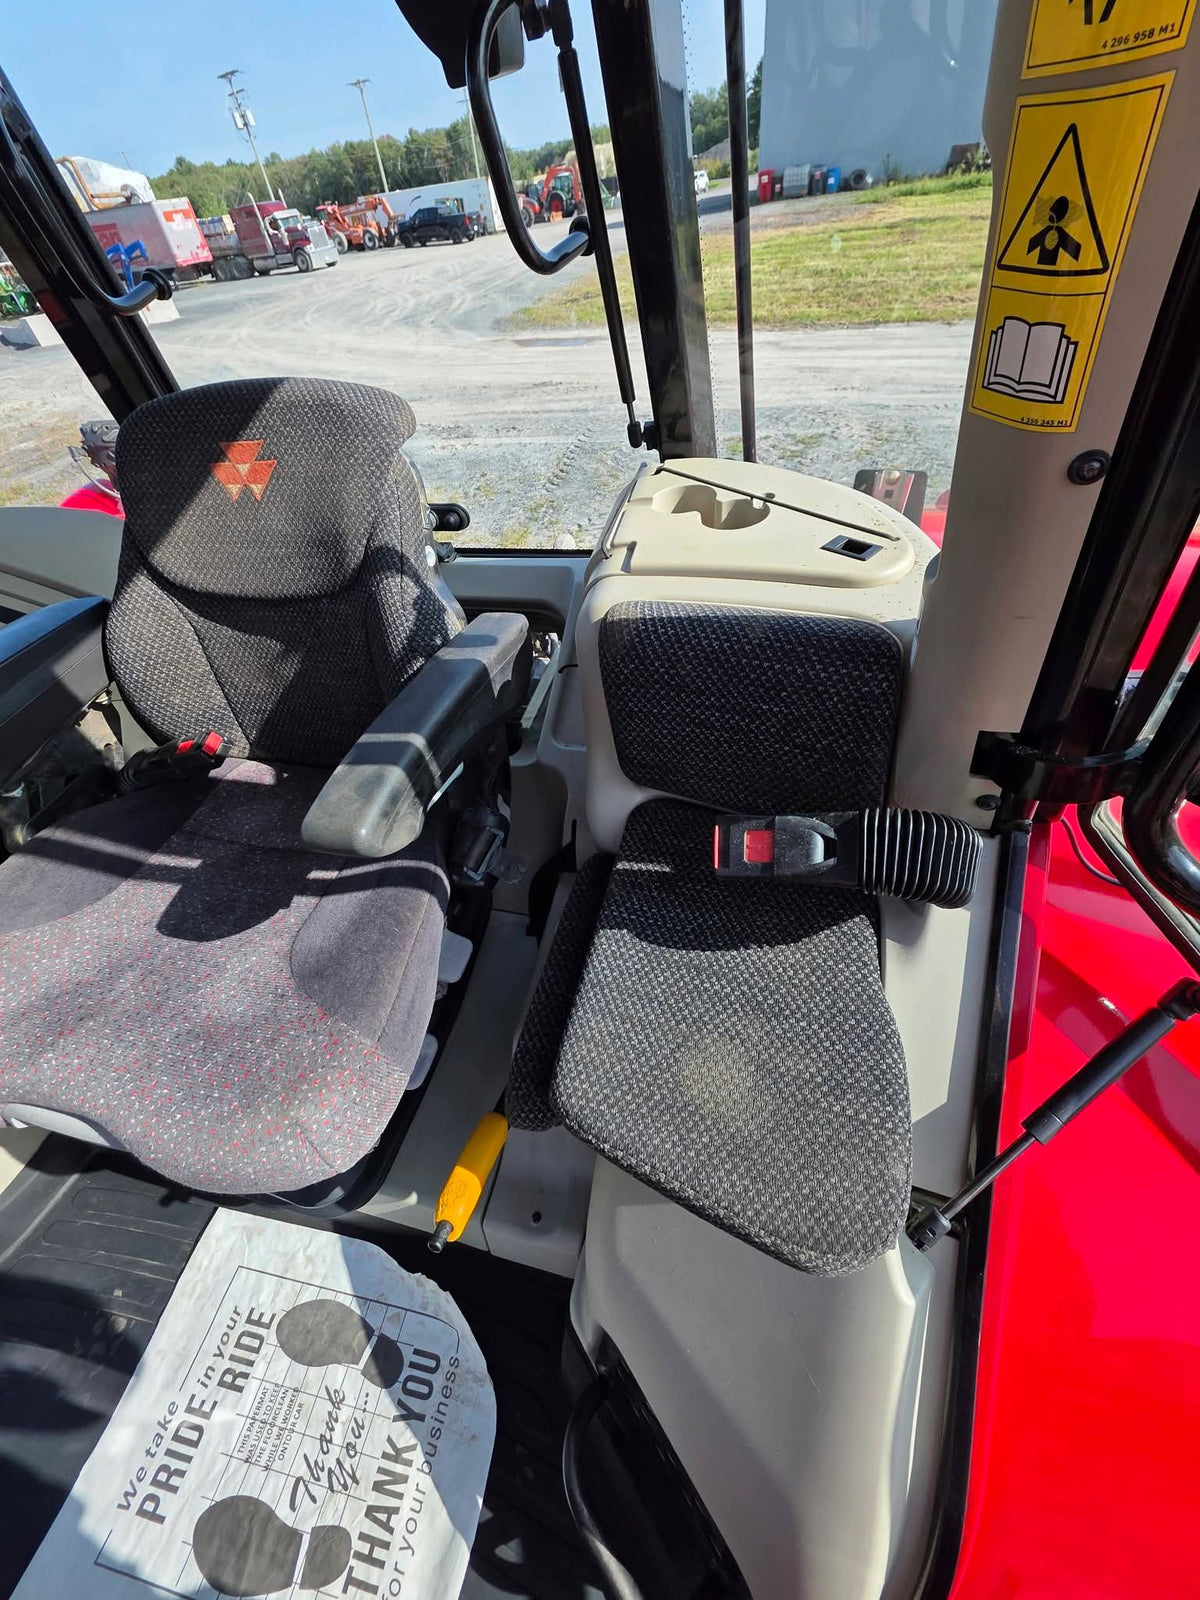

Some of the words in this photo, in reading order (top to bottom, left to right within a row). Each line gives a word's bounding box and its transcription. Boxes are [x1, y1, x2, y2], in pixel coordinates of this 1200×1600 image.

[1110, 34, 1130, 48] 296
[1133, 28, 1156, 42] 958
[1158, 22, 1176, 36] M1
[197, 1364, 216, 1389] in
[213, 1306, 242, 1360] your
[216, 1306, 277, 1394] RIDE
[237, 1432, 251, 1454] THIS
[247, 1385, 270, 1433] PAPERMAT
[243, 1443, 256, 1463] WAS
[253, 1418, 267, 1442] USED
[262, 1404, 273, 1416] TO
[268, 1383, 281, 1404] KEEP
[261, 1442, 279, 1472] WHILE
[274, 1426, 285, 1442] WE
[280, 1386, 300, 1425] WORKED
[289, 1384, 346, 1513] Thank
[293, 1402, 305, 1421] CAR
[116, 1466, 148, 1512] We
[145, 1400, 179, 1459] take
[135, 1393, 219, 1526] PRIDE
[253, 1446, 267, 1464] THE
[342, 1434, 418, 1595] THANK
[392, 1347, 441, 1424] YOU
[399, 1482, 426, 1557] your
[416, 1355, 460, 1476] business
